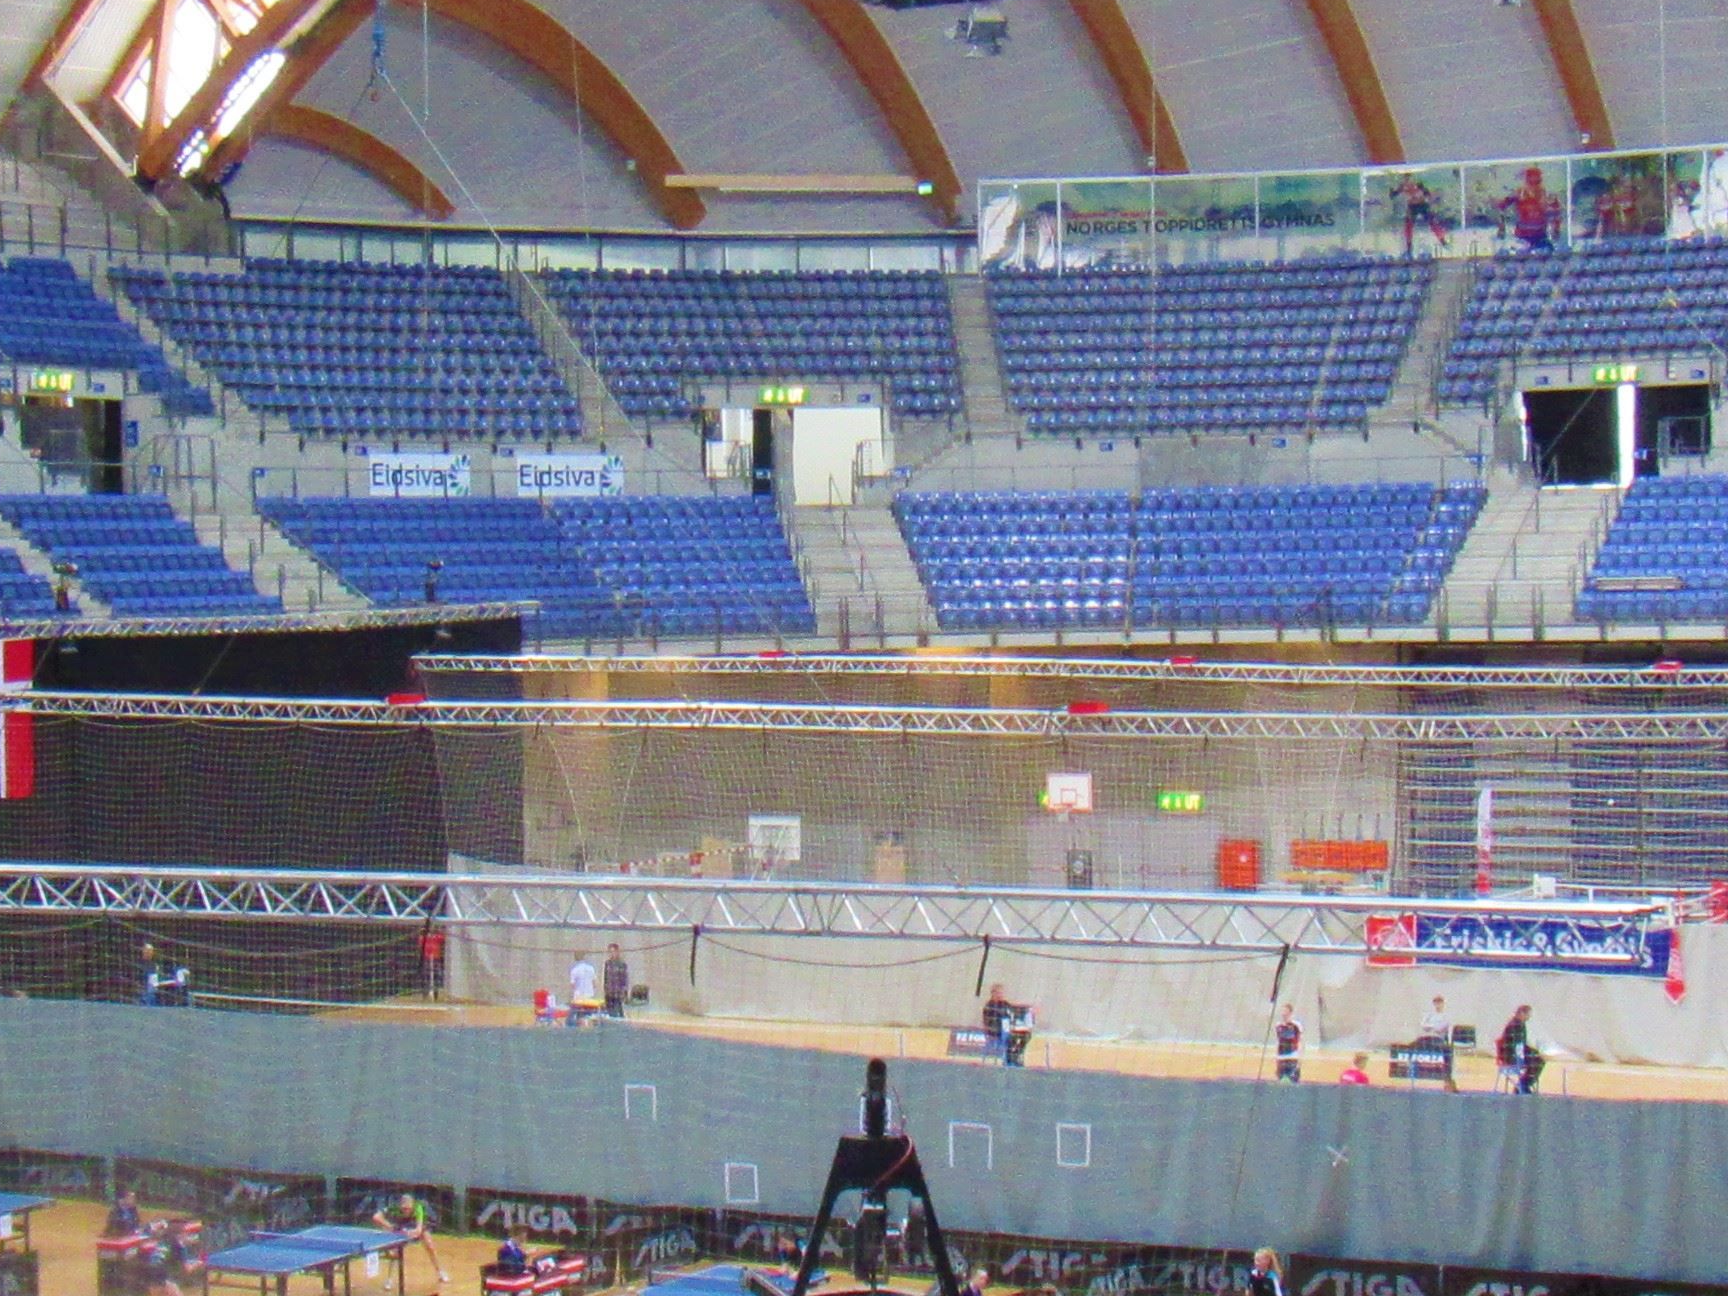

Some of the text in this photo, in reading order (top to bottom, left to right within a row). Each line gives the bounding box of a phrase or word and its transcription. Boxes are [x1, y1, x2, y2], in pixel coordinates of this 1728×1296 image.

[1065, 219, 1138, 235] NORGES
[371, 462, 445, 487] Eidsiva
[519, 464, 596, 488] Eidsiva
[476, 1199, 578, 1235] STIGA
[633, 1224, 697, 1268] STIGA
